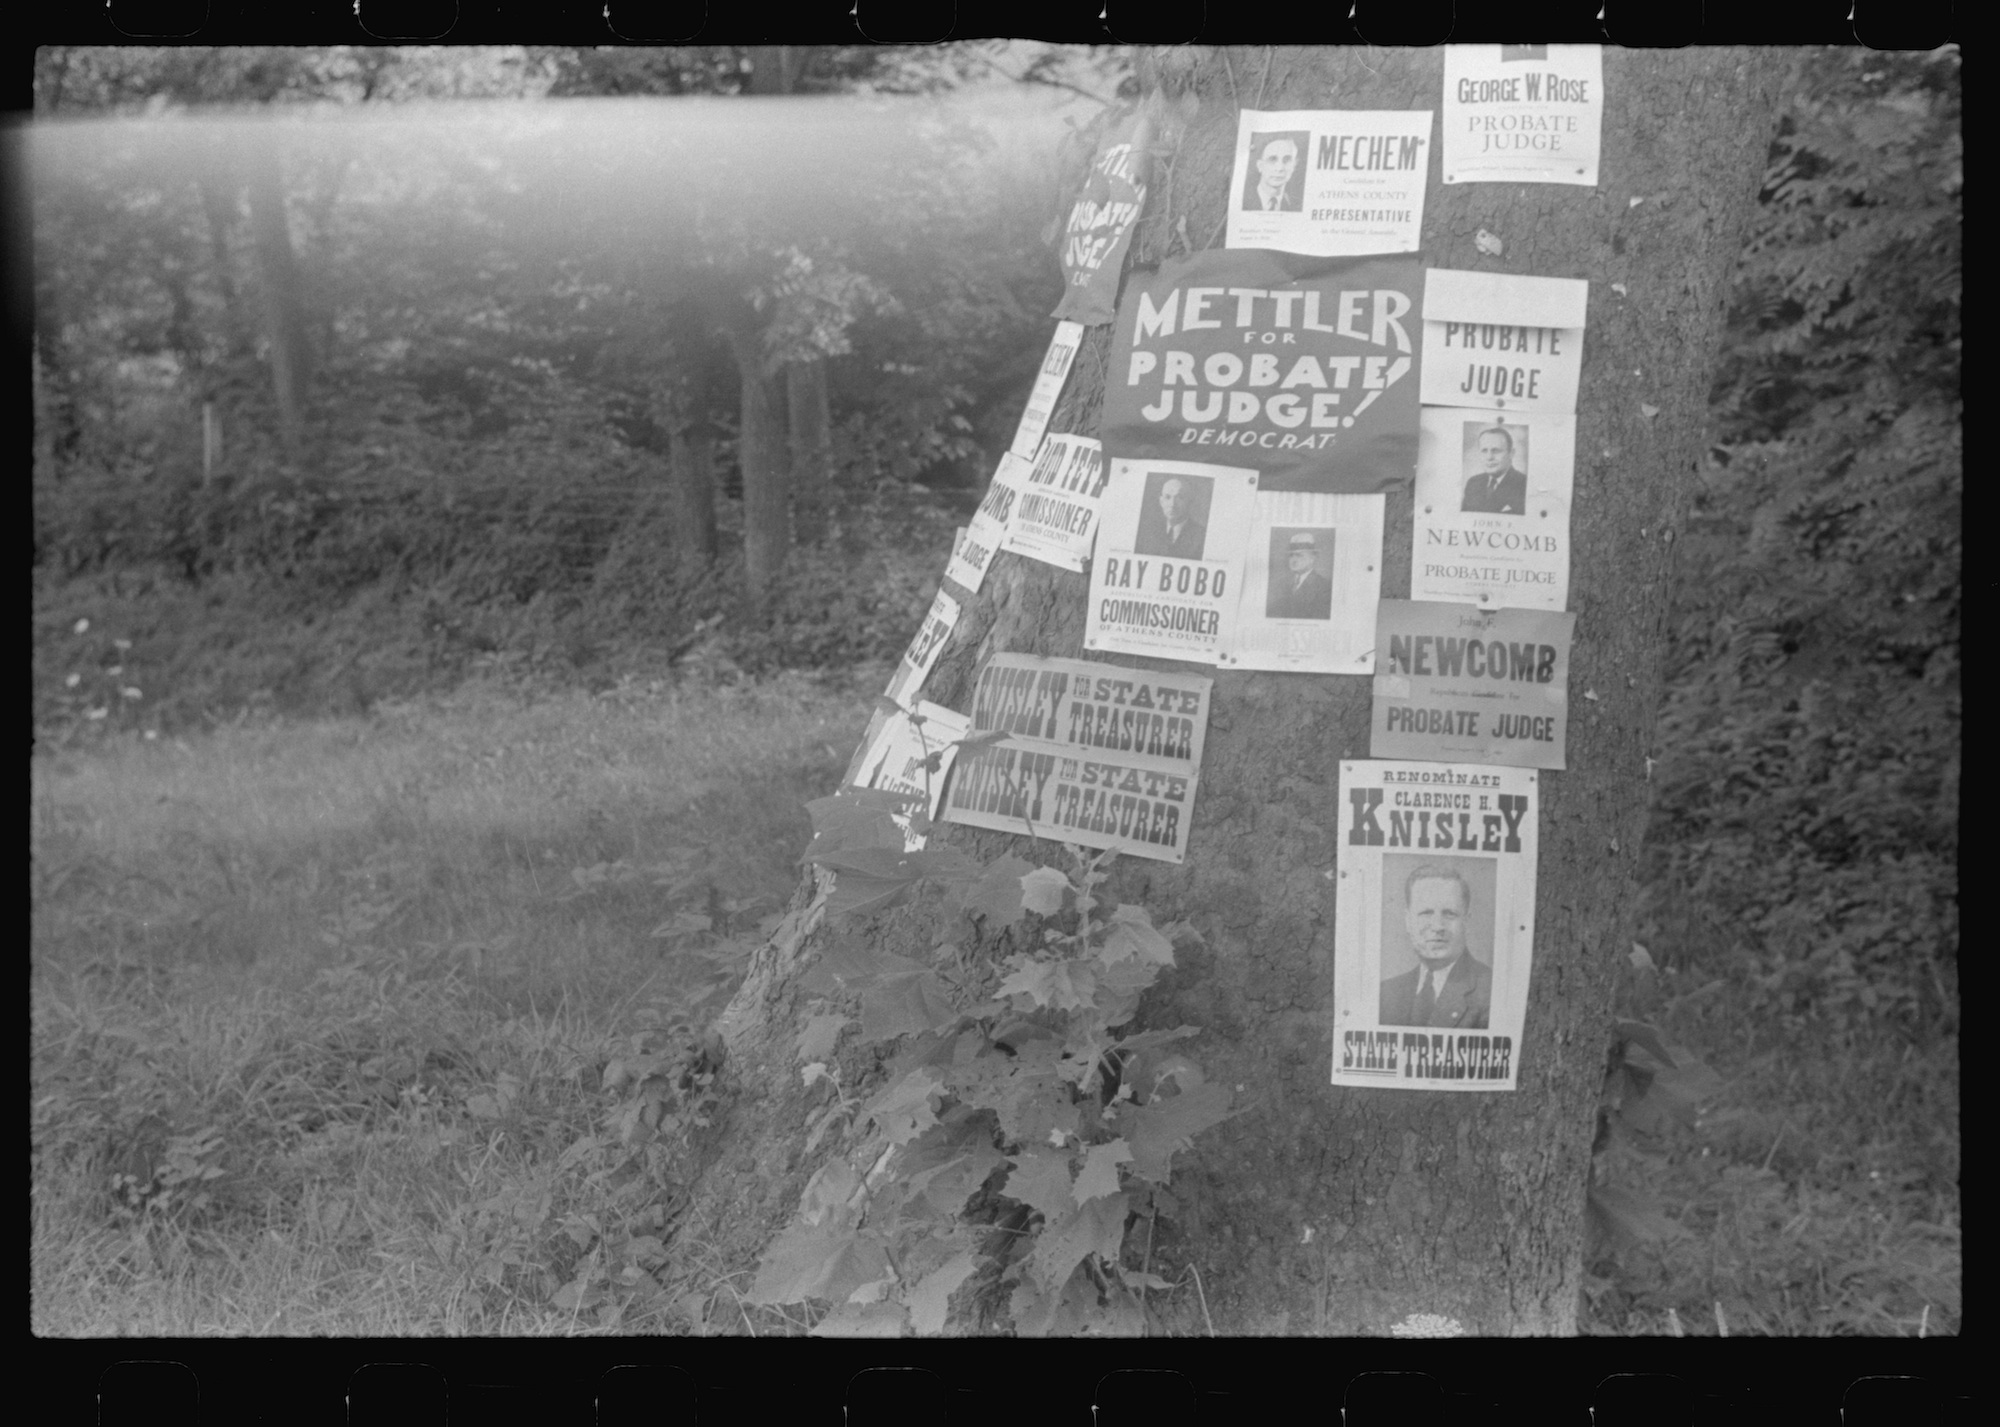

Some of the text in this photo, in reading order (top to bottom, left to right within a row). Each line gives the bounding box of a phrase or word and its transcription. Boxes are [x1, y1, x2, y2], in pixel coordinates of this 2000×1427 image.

[1457, 72, 1589, 104] GEORGE W. ROSE
[1468, 114, 1578, 133] PROBATE
[1317, 135, 1420, 171] MECHEM
[1482, 134, 1562, 153] JUDGE
[1318, 190, 1409, 200] ATHENS COUNTY
[1311, 208, 1412, 223] REPRESENTATIVE
[1132, 287, 1412, 354] METTLER
[1244, 332, 1296, 344] FOR
[1445, 321, 1561, 356] PROBATE
[1460, 364, 1541, 400] JUDGE
[1180, 428, 1336, 449] DEMOCRAT
[1018, 492, 1093, 537] COMMISSIONER
[1473, 519, 1502, 528] JOHN
[1427, 528, 1557, 552] NEWCOMB
[1104, 558, 1227, 599] RAY BOBO
[1425, 564, 1557, 585] PROBATE JUDGE
[1099, 598, 1220, 636] COMMISSIONER
[1099, 624, 1218, 645] OF ATHENS COUNTY
[1458, 616, 1482, 627] John
[1389, 634, 1556, 684] NEWCOMB
[974, 666, 1069, 739] KNISLEY
[1073, 675, 1091, 697] FOR
[1094, 677, 1200, 716] STATE
[1068, 701, 1194, 760] TREASURER
[1387, 706, 1555, 742] PROBATE JUDGE
[952, 745, 1056, 821] KNISLEY
[1081, 762, 1188, 802] STATE
[1383, 770, 1501, 786] RENOMINATE
[1053, 783, 1180, 848] TREASURER
[1395, 791, 1493, 811] CLARENCE H.
[1349, 787, 1528, 853] KNISLEY
[1343, 1030, 1512, 1080] STATE TREASURER
